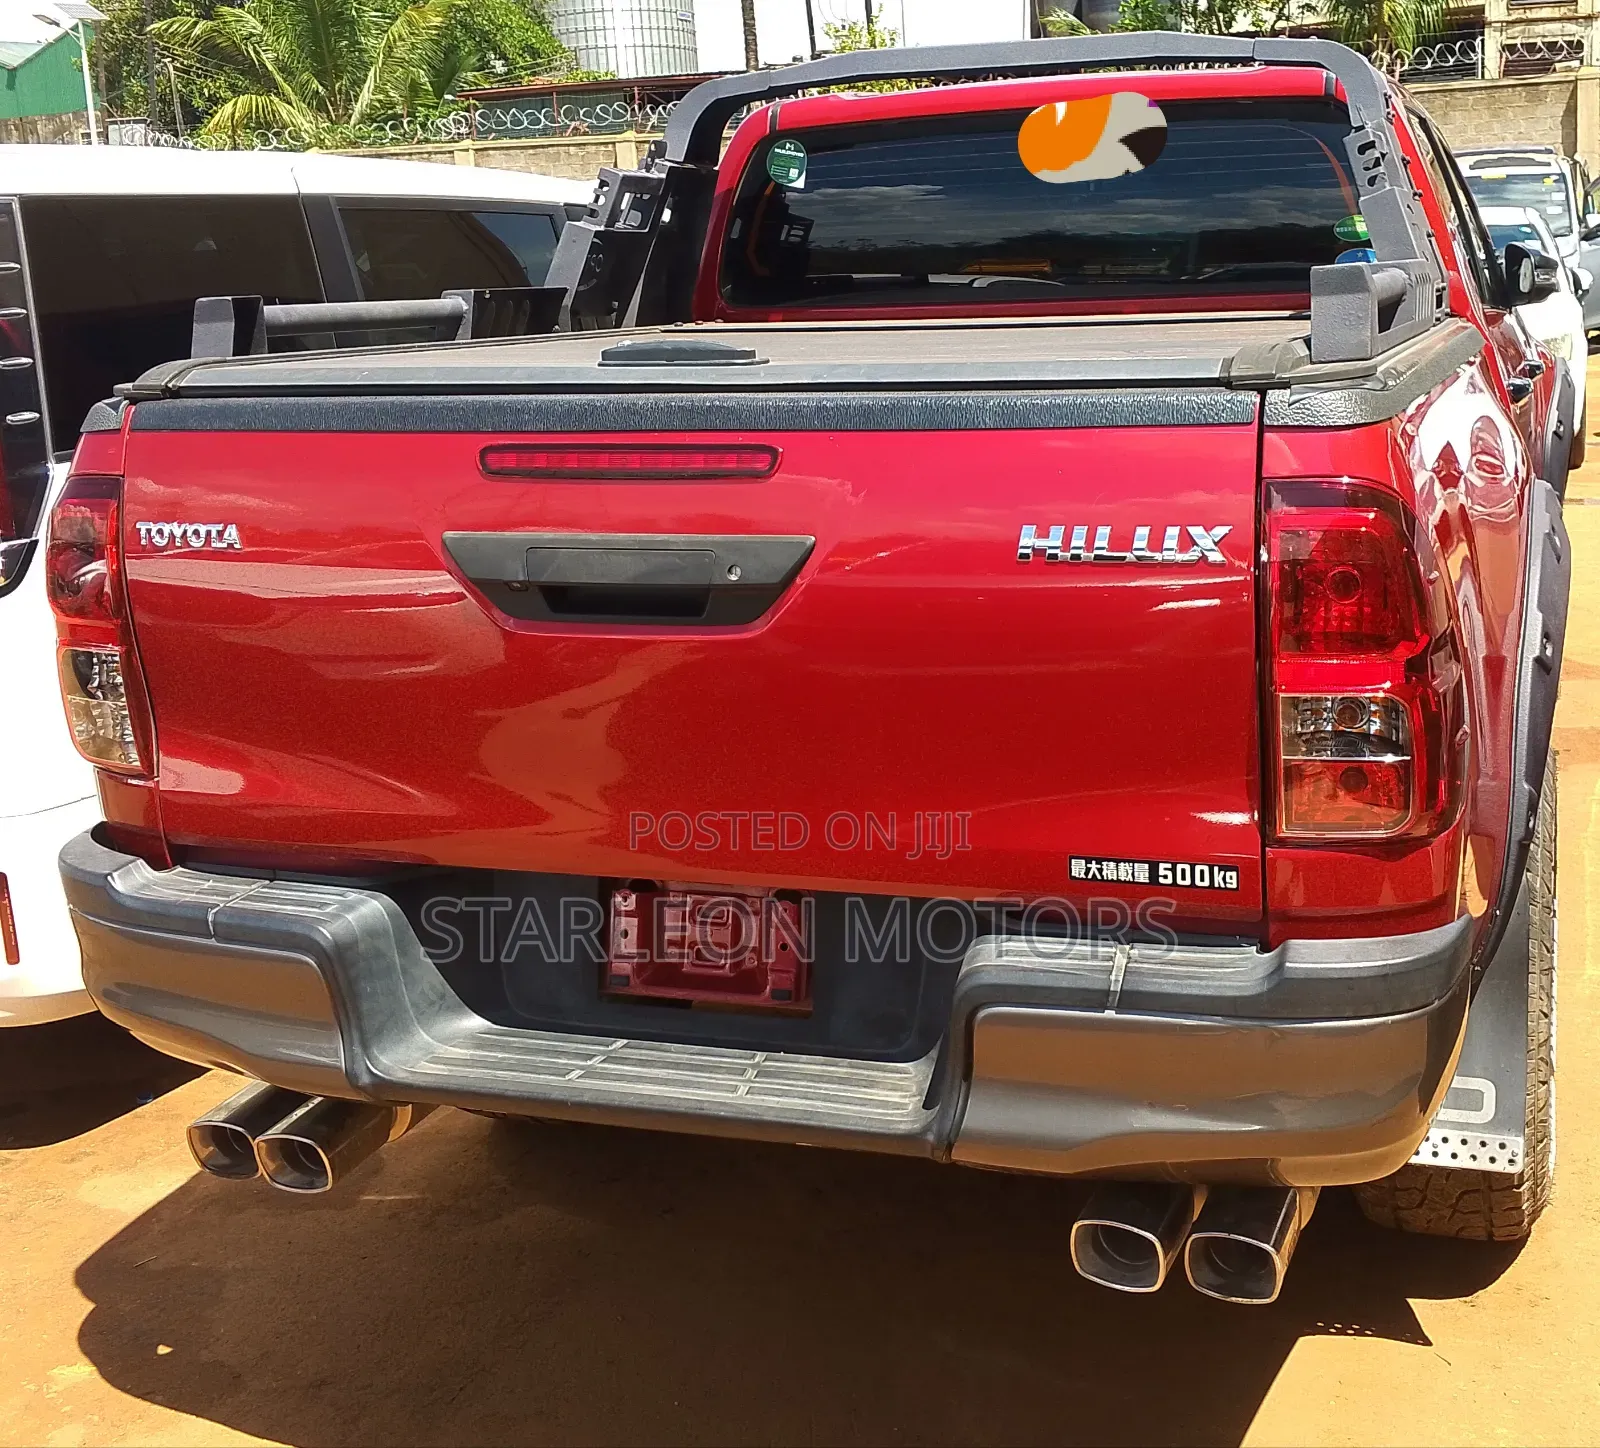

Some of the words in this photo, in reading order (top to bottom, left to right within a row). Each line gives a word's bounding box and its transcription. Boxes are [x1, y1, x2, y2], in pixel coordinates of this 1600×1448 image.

[136, 521, 242, 549] TOYOTA
[1016, 524, 1233, 563] HILUX
[1070, 858, 1150, 884] 最大積載量
[1158, 862, 1238, 889] 500kg
